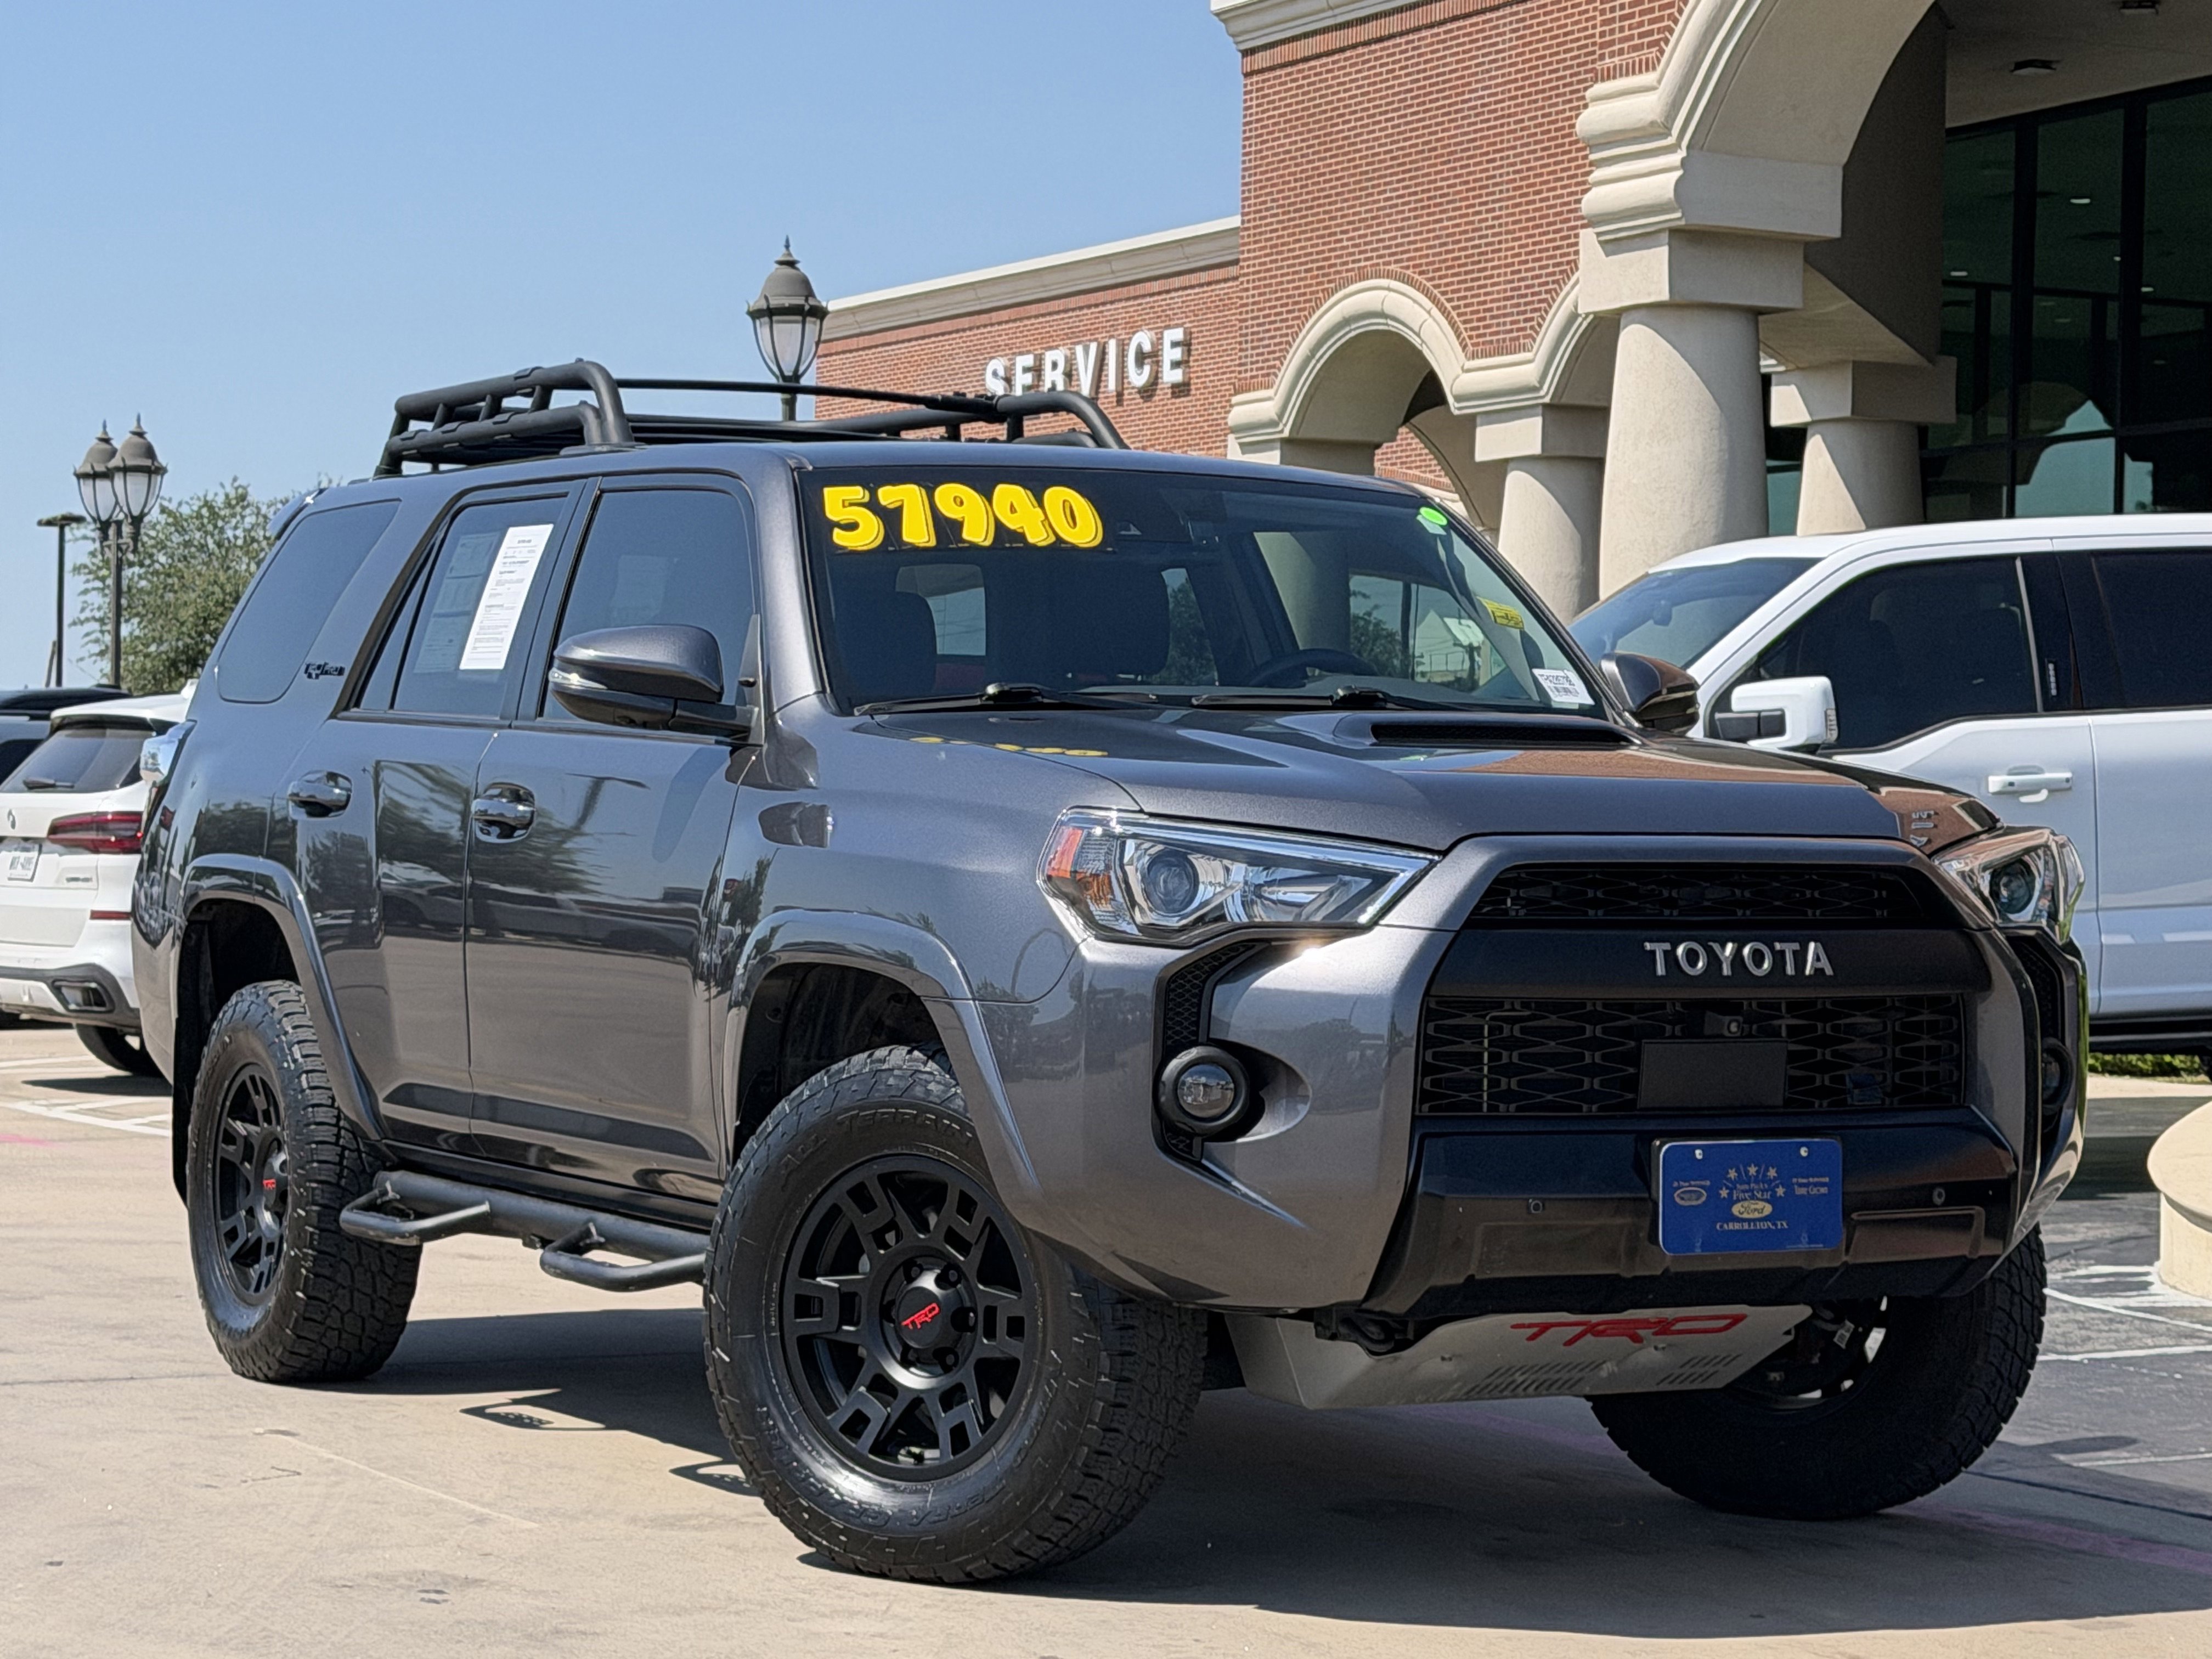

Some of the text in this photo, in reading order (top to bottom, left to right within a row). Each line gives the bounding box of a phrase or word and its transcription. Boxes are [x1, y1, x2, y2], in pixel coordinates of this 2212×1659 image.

[985, 326, 1189, 396] SERVICE
[823, 483, 1103, 551] 57940
[1644, 940, 1835, 977] TOYOTA
[1738, 1201, 1766, 1216] Ford
[1753, 1189, 1772, 1200] Star
[1776, 1220, 1788, 1229] TX
[901, 1302, 940, 1330] TRD
[1510, 1313, 1747, 1347] TRD
